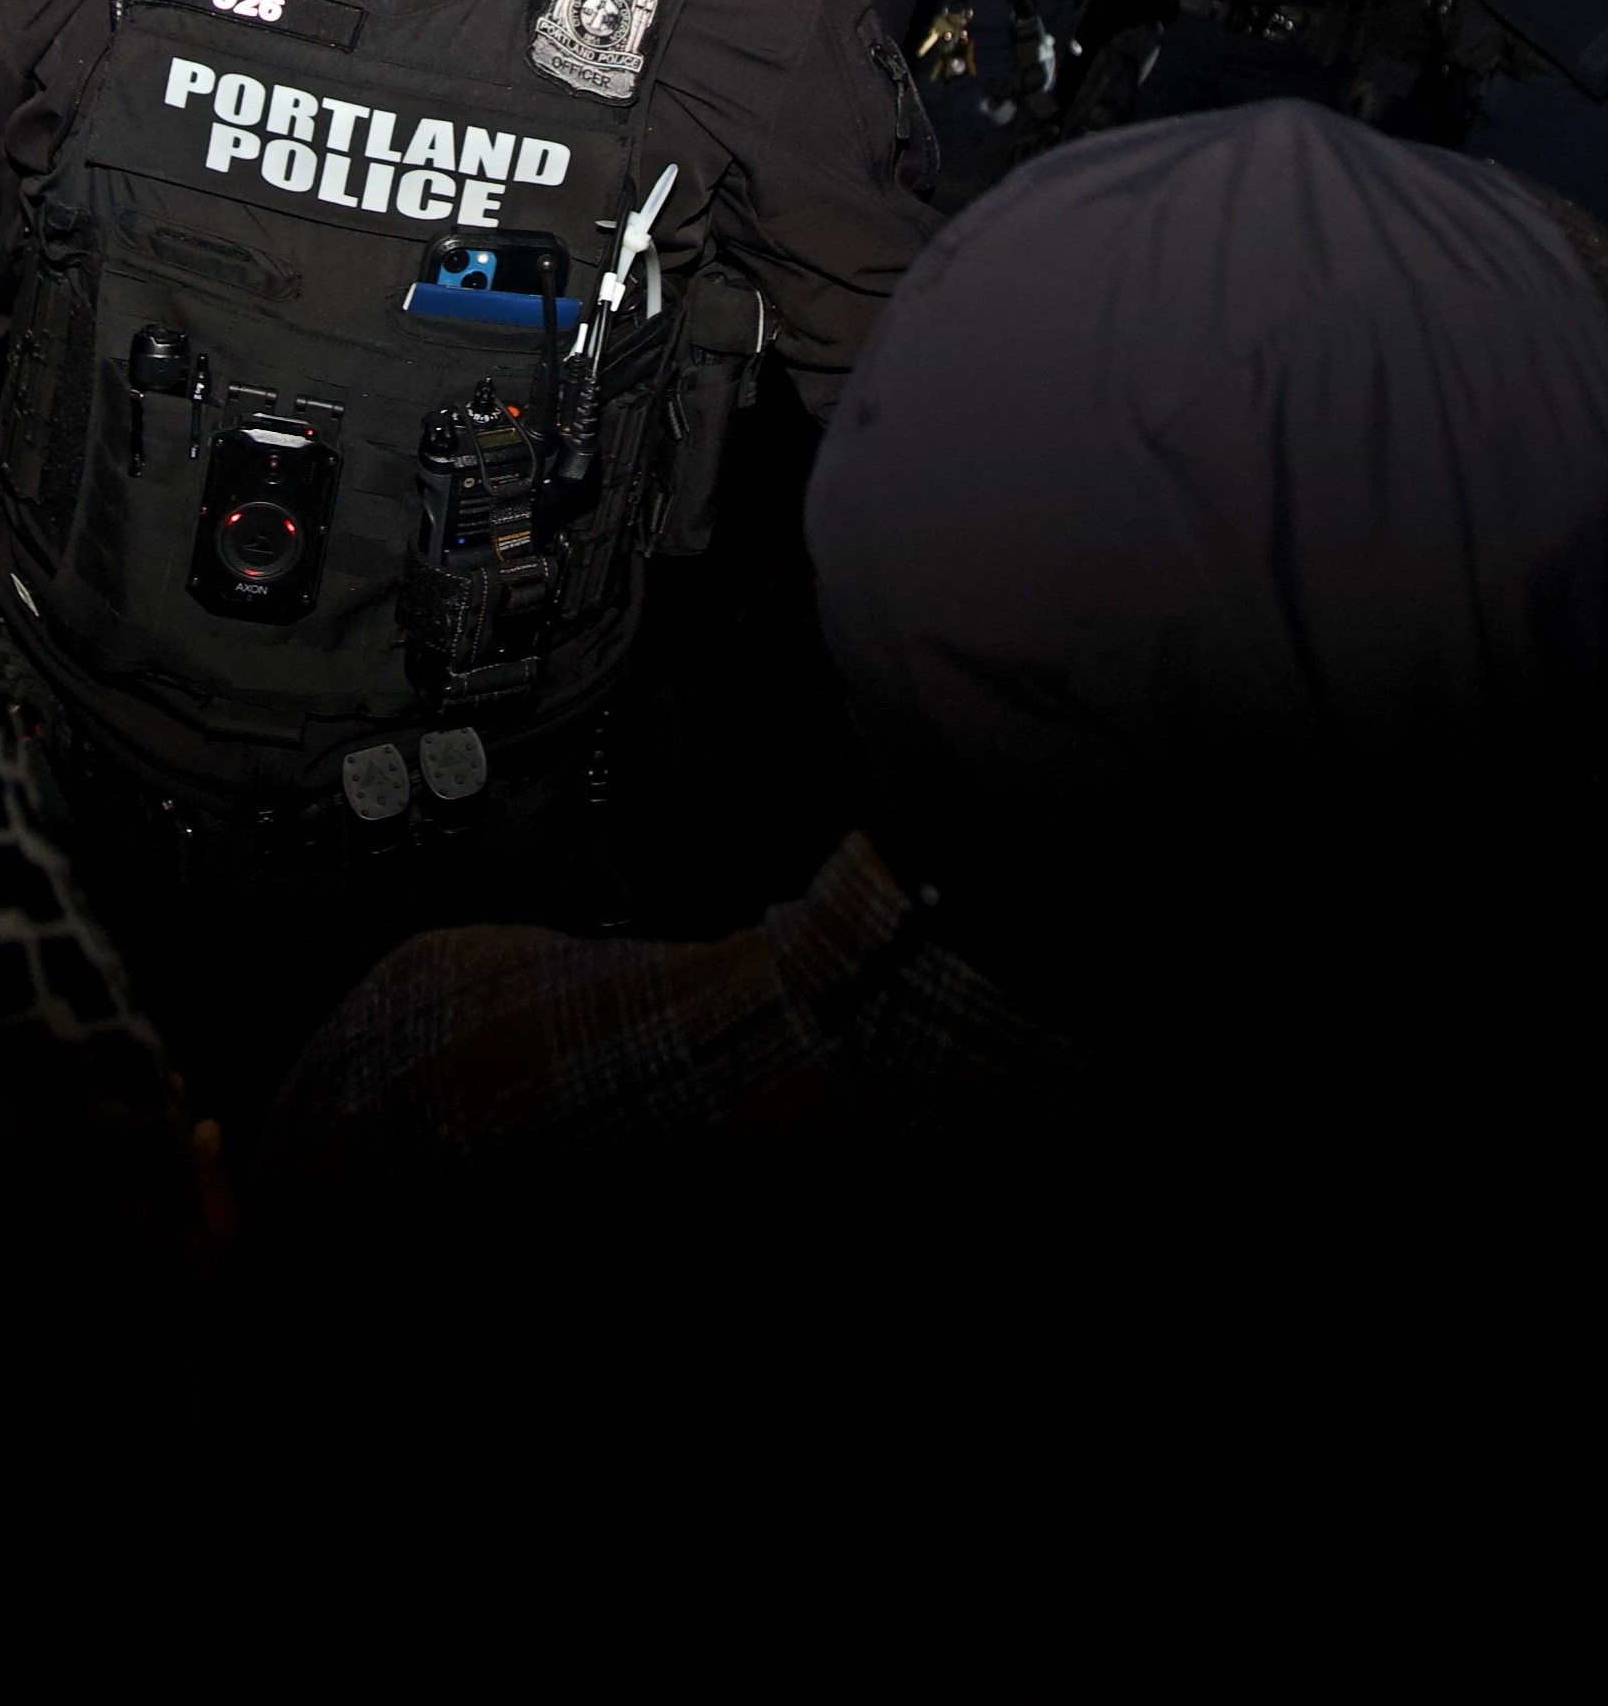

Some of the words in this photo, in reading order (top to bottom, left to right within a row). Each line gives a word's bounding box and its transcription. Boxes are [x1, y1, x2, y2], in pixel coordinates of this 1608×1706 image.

[539, 21, 595, 62] PORTLAND
[597, 52, 642, 69] POLICE
[551, 55, 611, 89] OFFICER
[163, 56, 572, 187] PORTLAND
[204, 122, 507, 228] POLICE
[234, 583, 269, 595] AXON
